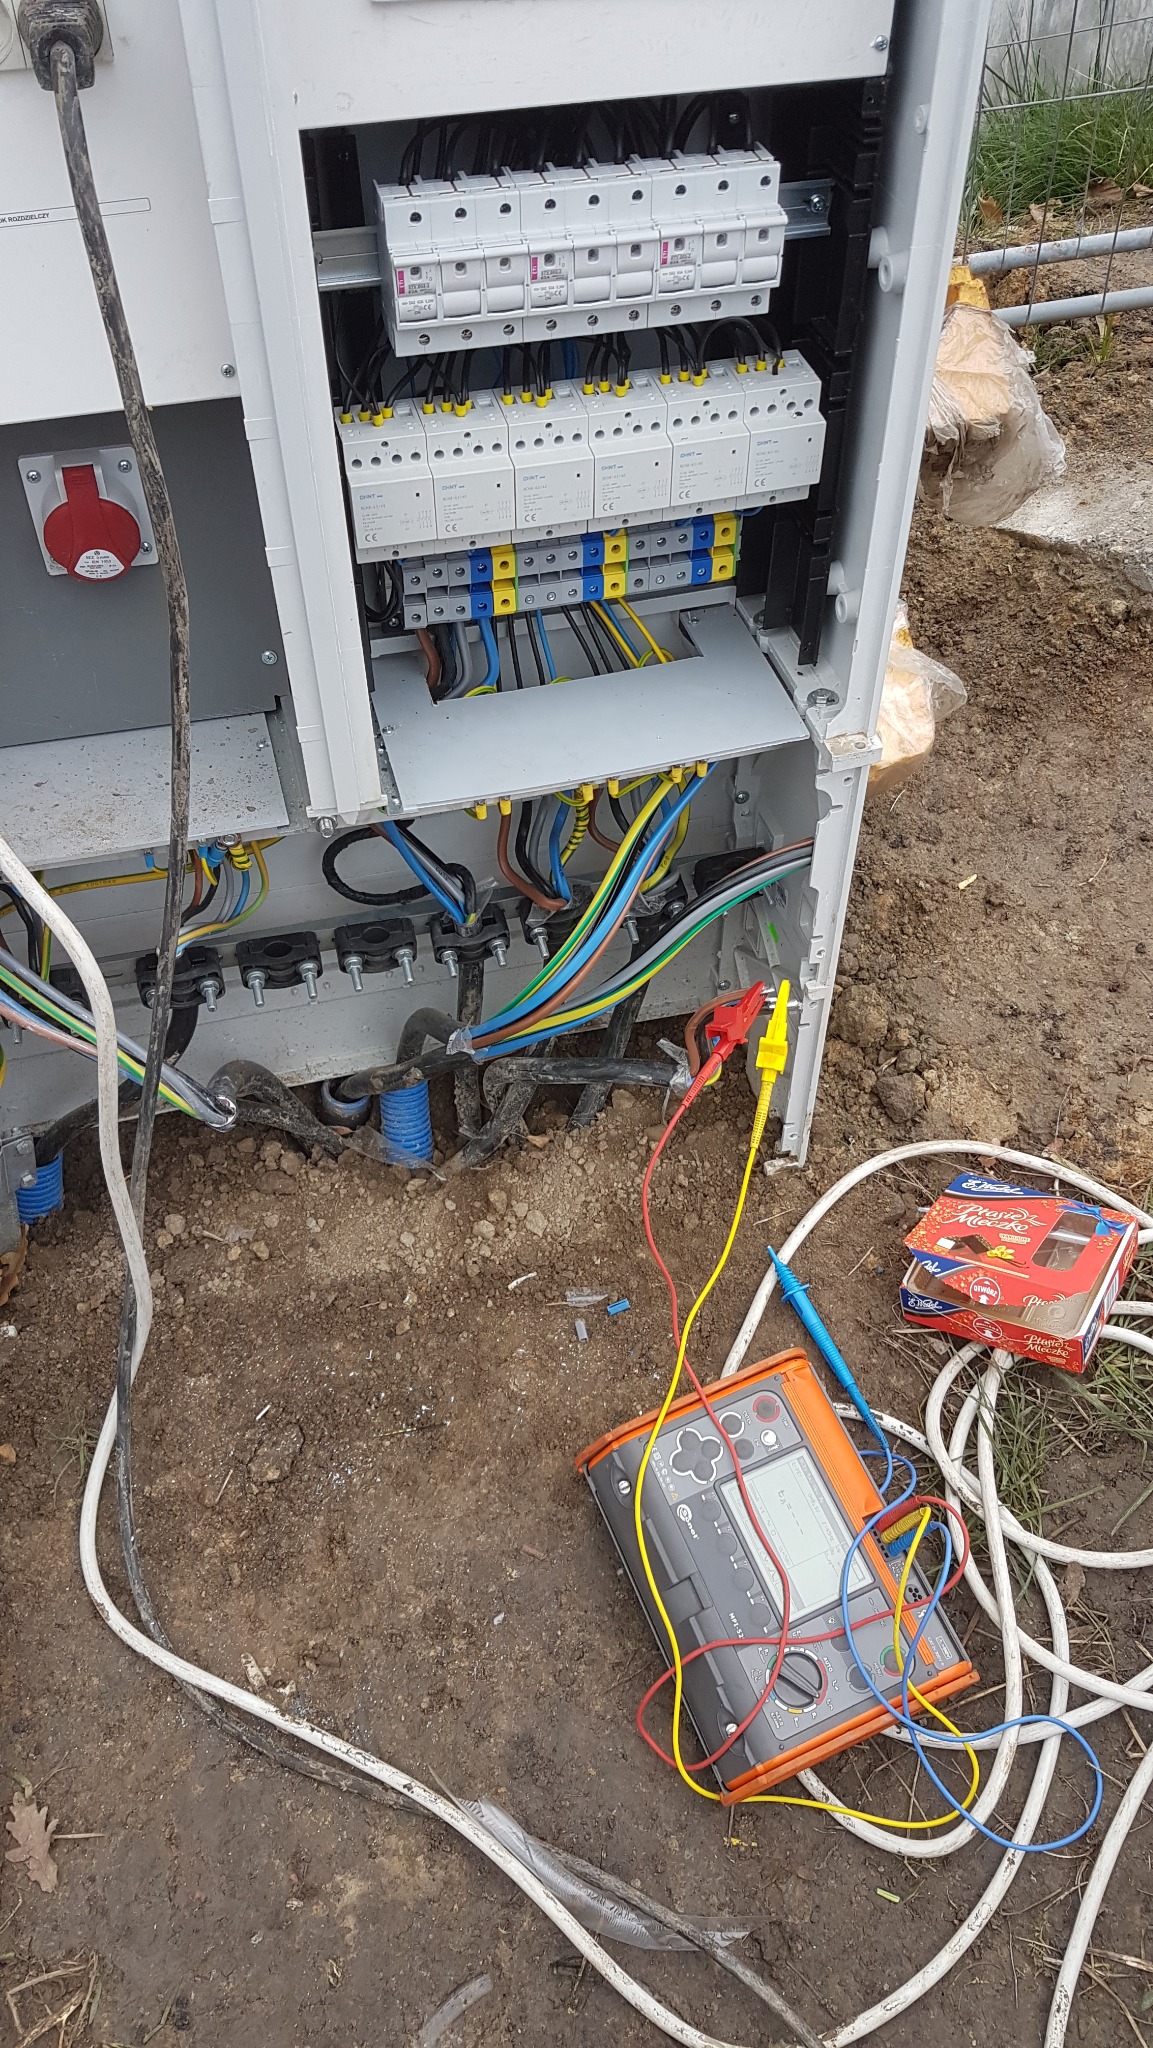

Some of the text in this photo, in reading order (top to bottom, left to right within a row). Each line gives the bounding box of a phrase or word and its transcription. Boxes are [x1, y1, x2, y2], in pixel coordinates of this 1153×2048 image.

[8, 213, 49, 222] ROZDZIELCZY
[973, 1286, 998, 1296] OTWÓRZ
[728, 1612, 745, 1639] MPI-52
[823, 1657, 834, 1673] AUTO
